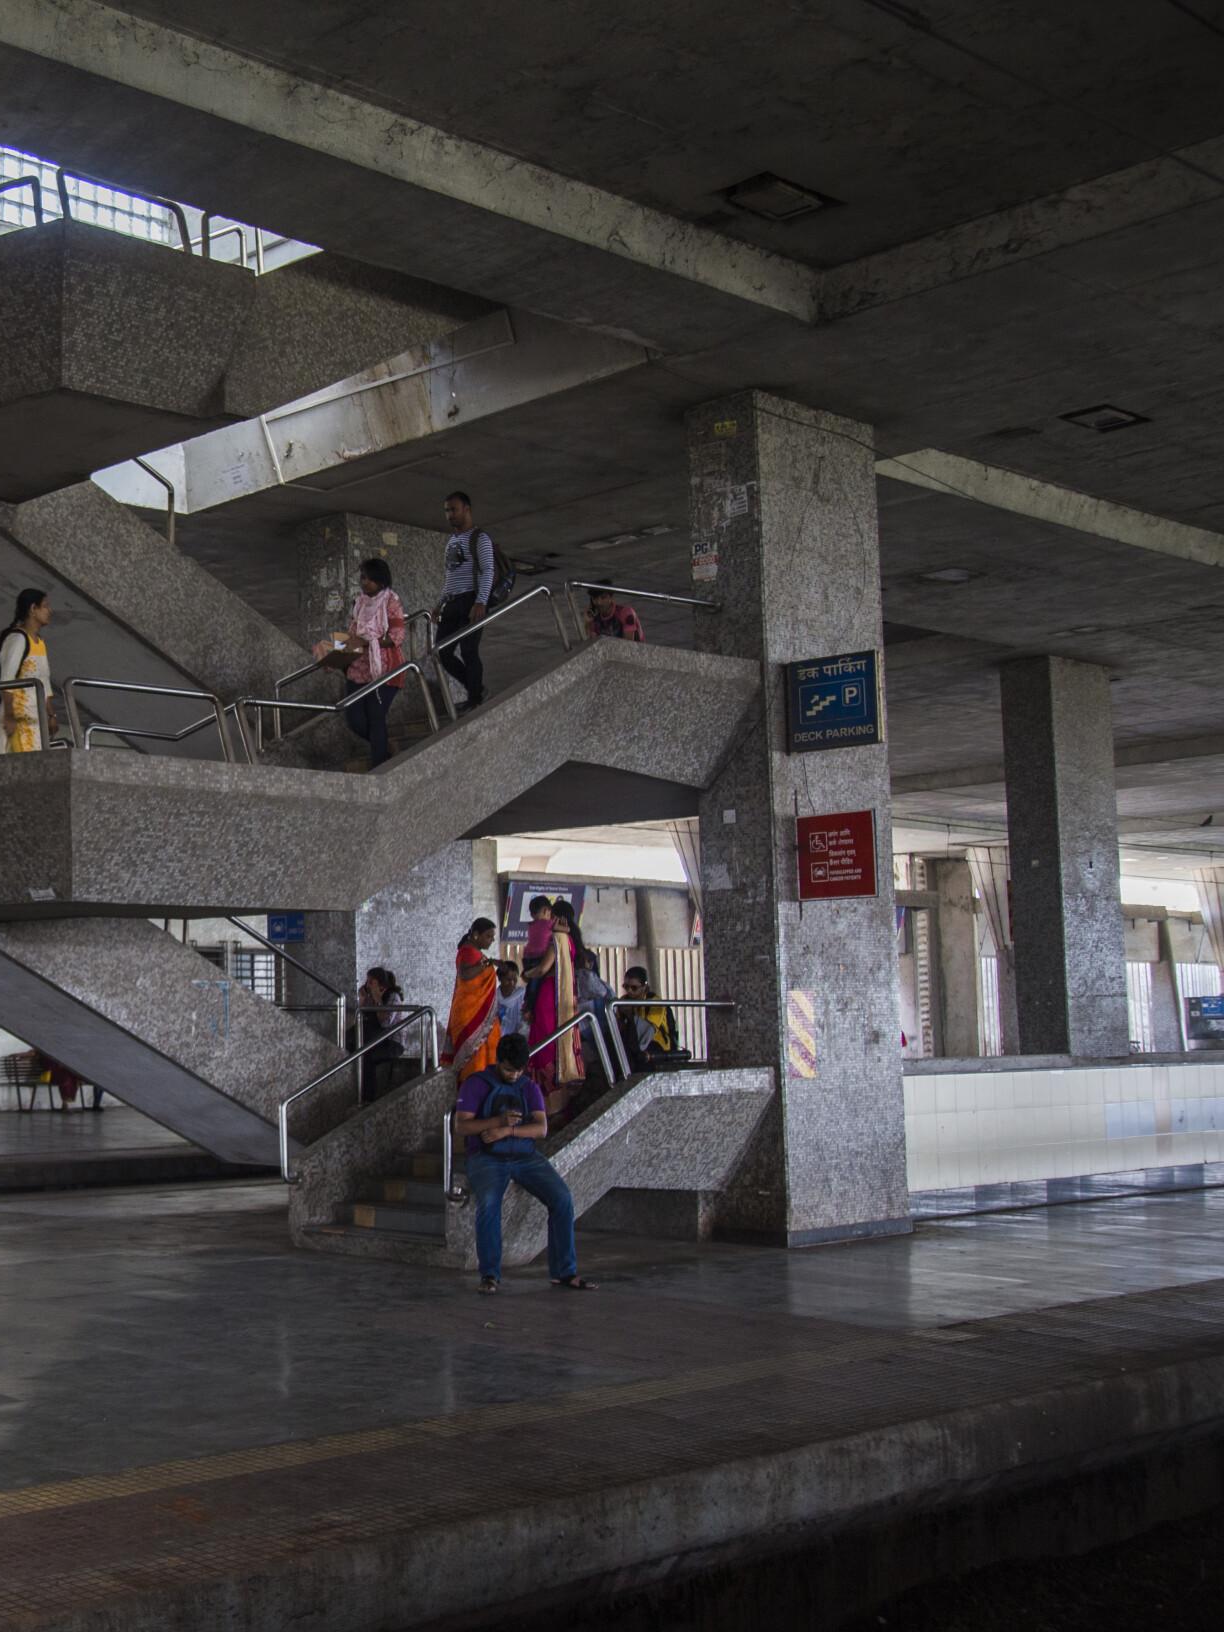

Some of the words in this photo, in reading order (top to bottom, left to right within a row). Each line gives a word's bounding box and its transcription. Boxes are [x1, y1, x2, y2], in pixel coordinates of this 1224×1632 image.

[694, 543, 708, 555] PG
[823, 657, 867, 677] पार्किंग
[845, 687, 858, 704] P
[794, 731, 823, 743] DECK
[826, 724, 874, 739] PARKING
